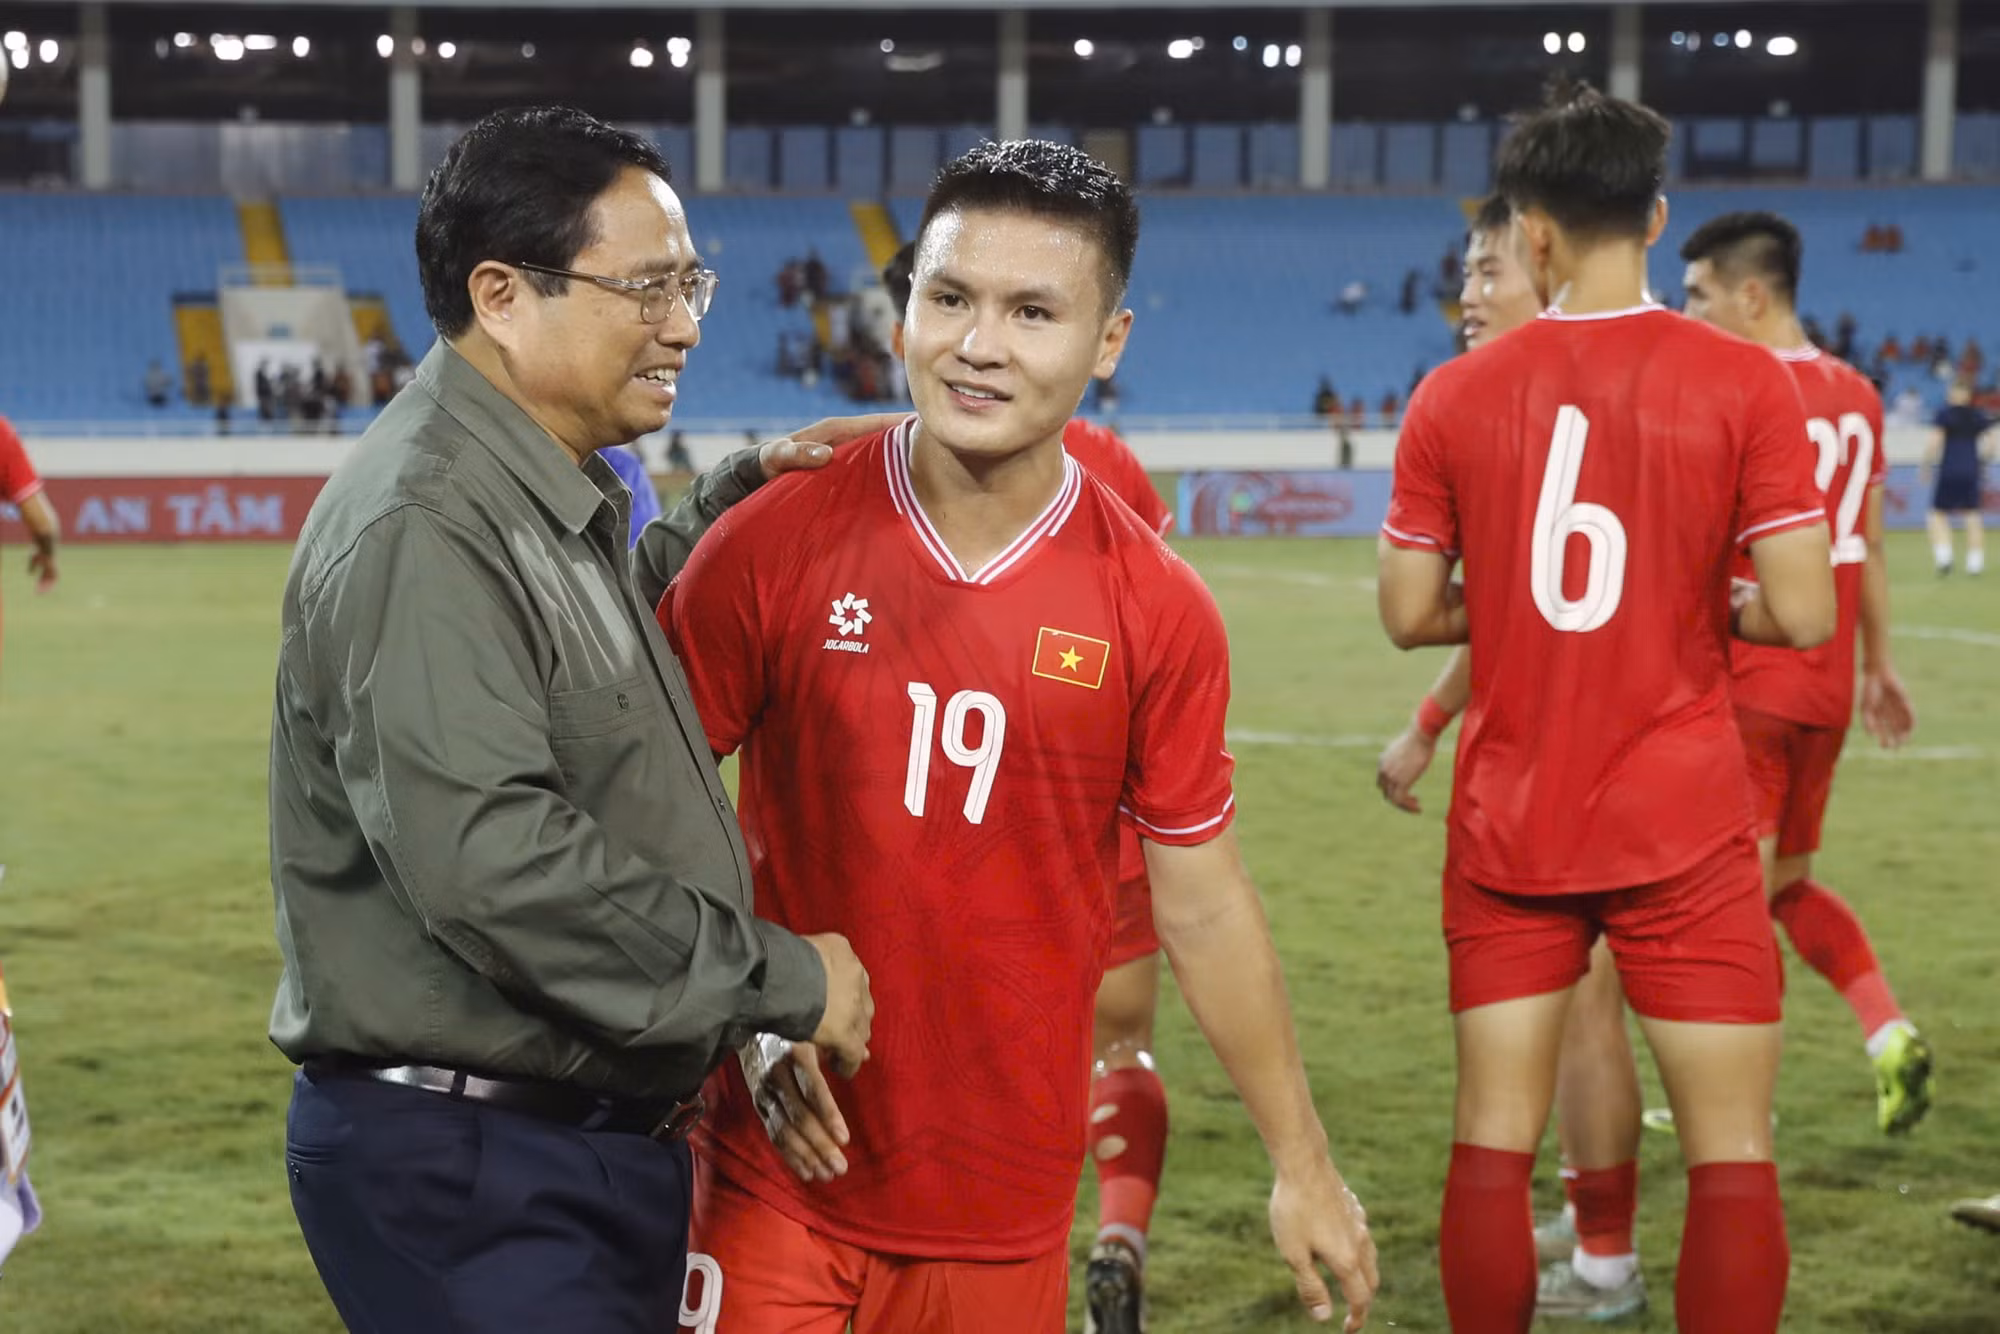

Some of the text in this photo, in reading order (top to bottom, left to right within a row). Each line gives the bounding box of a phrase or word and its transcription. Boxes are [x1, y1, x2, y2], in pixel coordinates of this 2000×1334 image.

[77, 496, 148, 533] AN
[1531, 405, 1627, 632] 6
[904, 681, 1006, 825] 19
